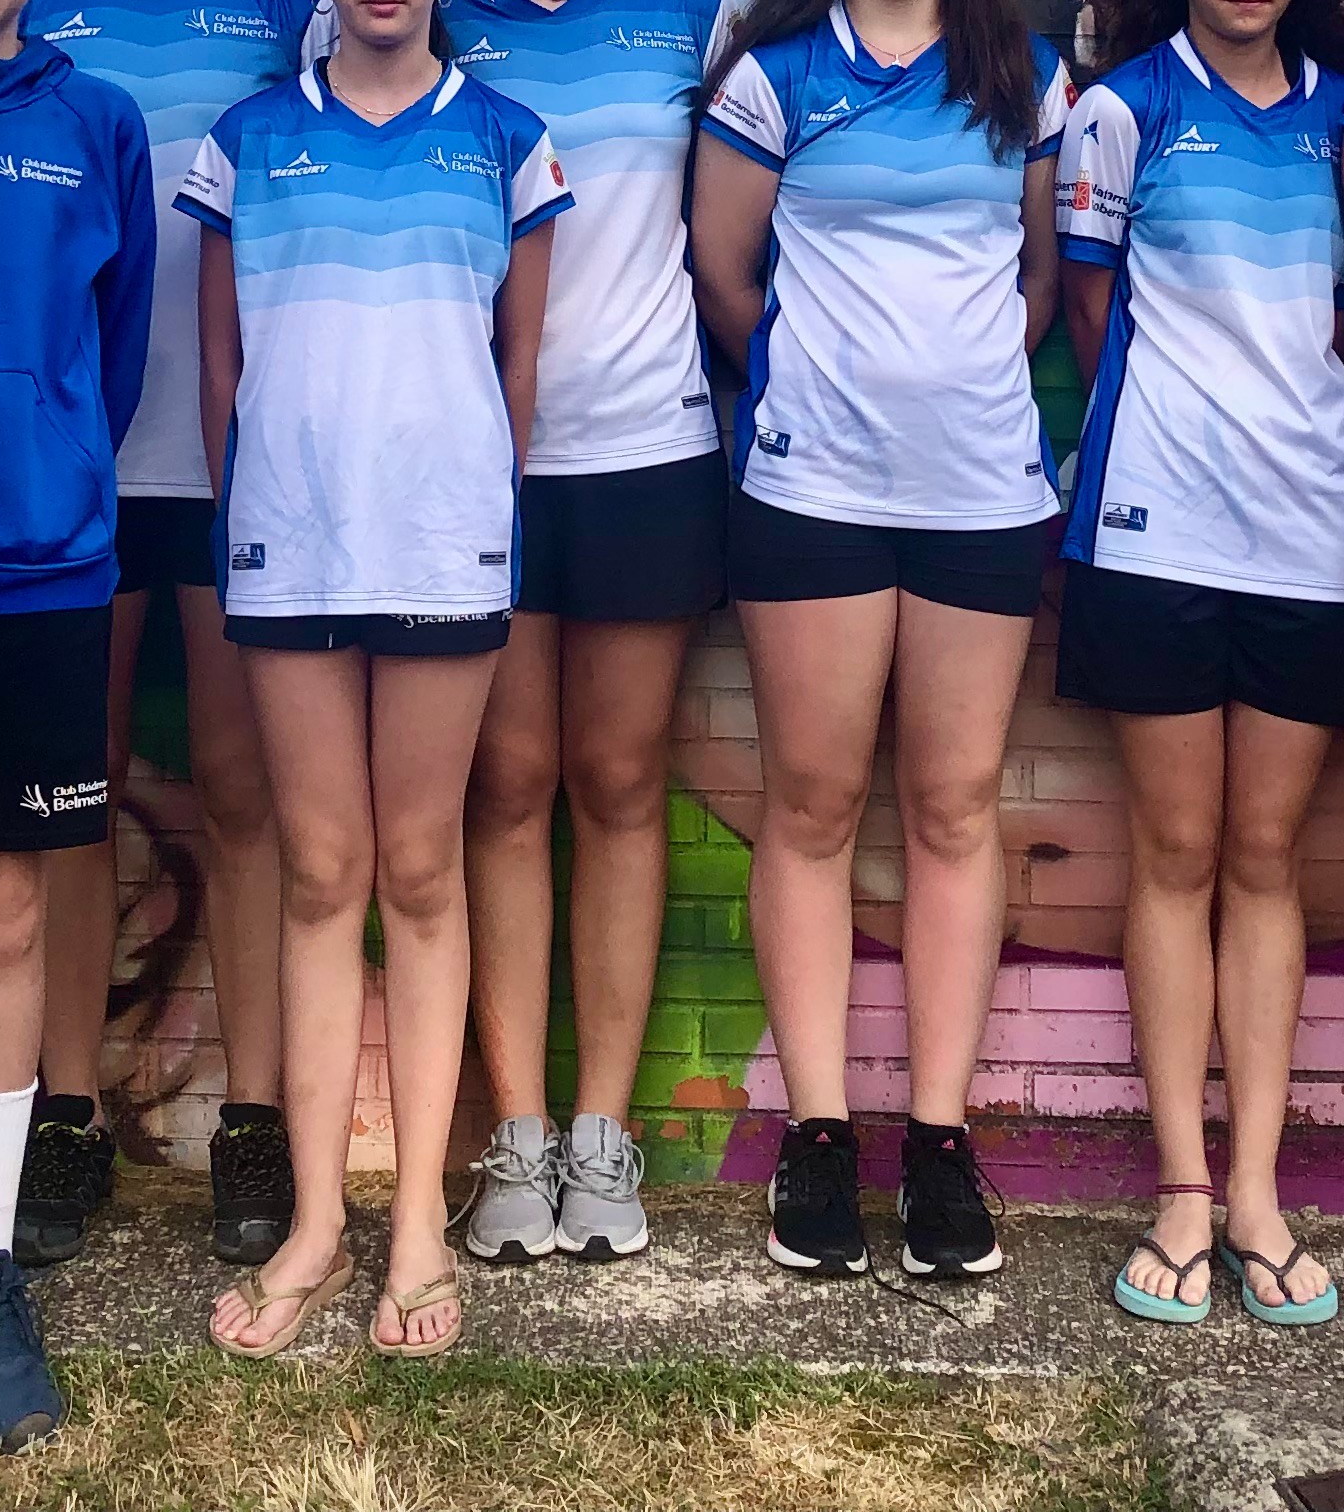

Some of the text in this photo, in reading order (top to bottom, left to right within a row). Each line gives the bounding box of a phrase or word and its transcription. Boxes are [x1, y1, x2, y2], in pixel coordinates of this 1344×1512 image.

[725, 93, 766, 125] Nafarroako
[20, 166, 82, 189] Belmecher
[269, 164, 330, 180] MERCURY
[53, 784, 77, 797] Club
